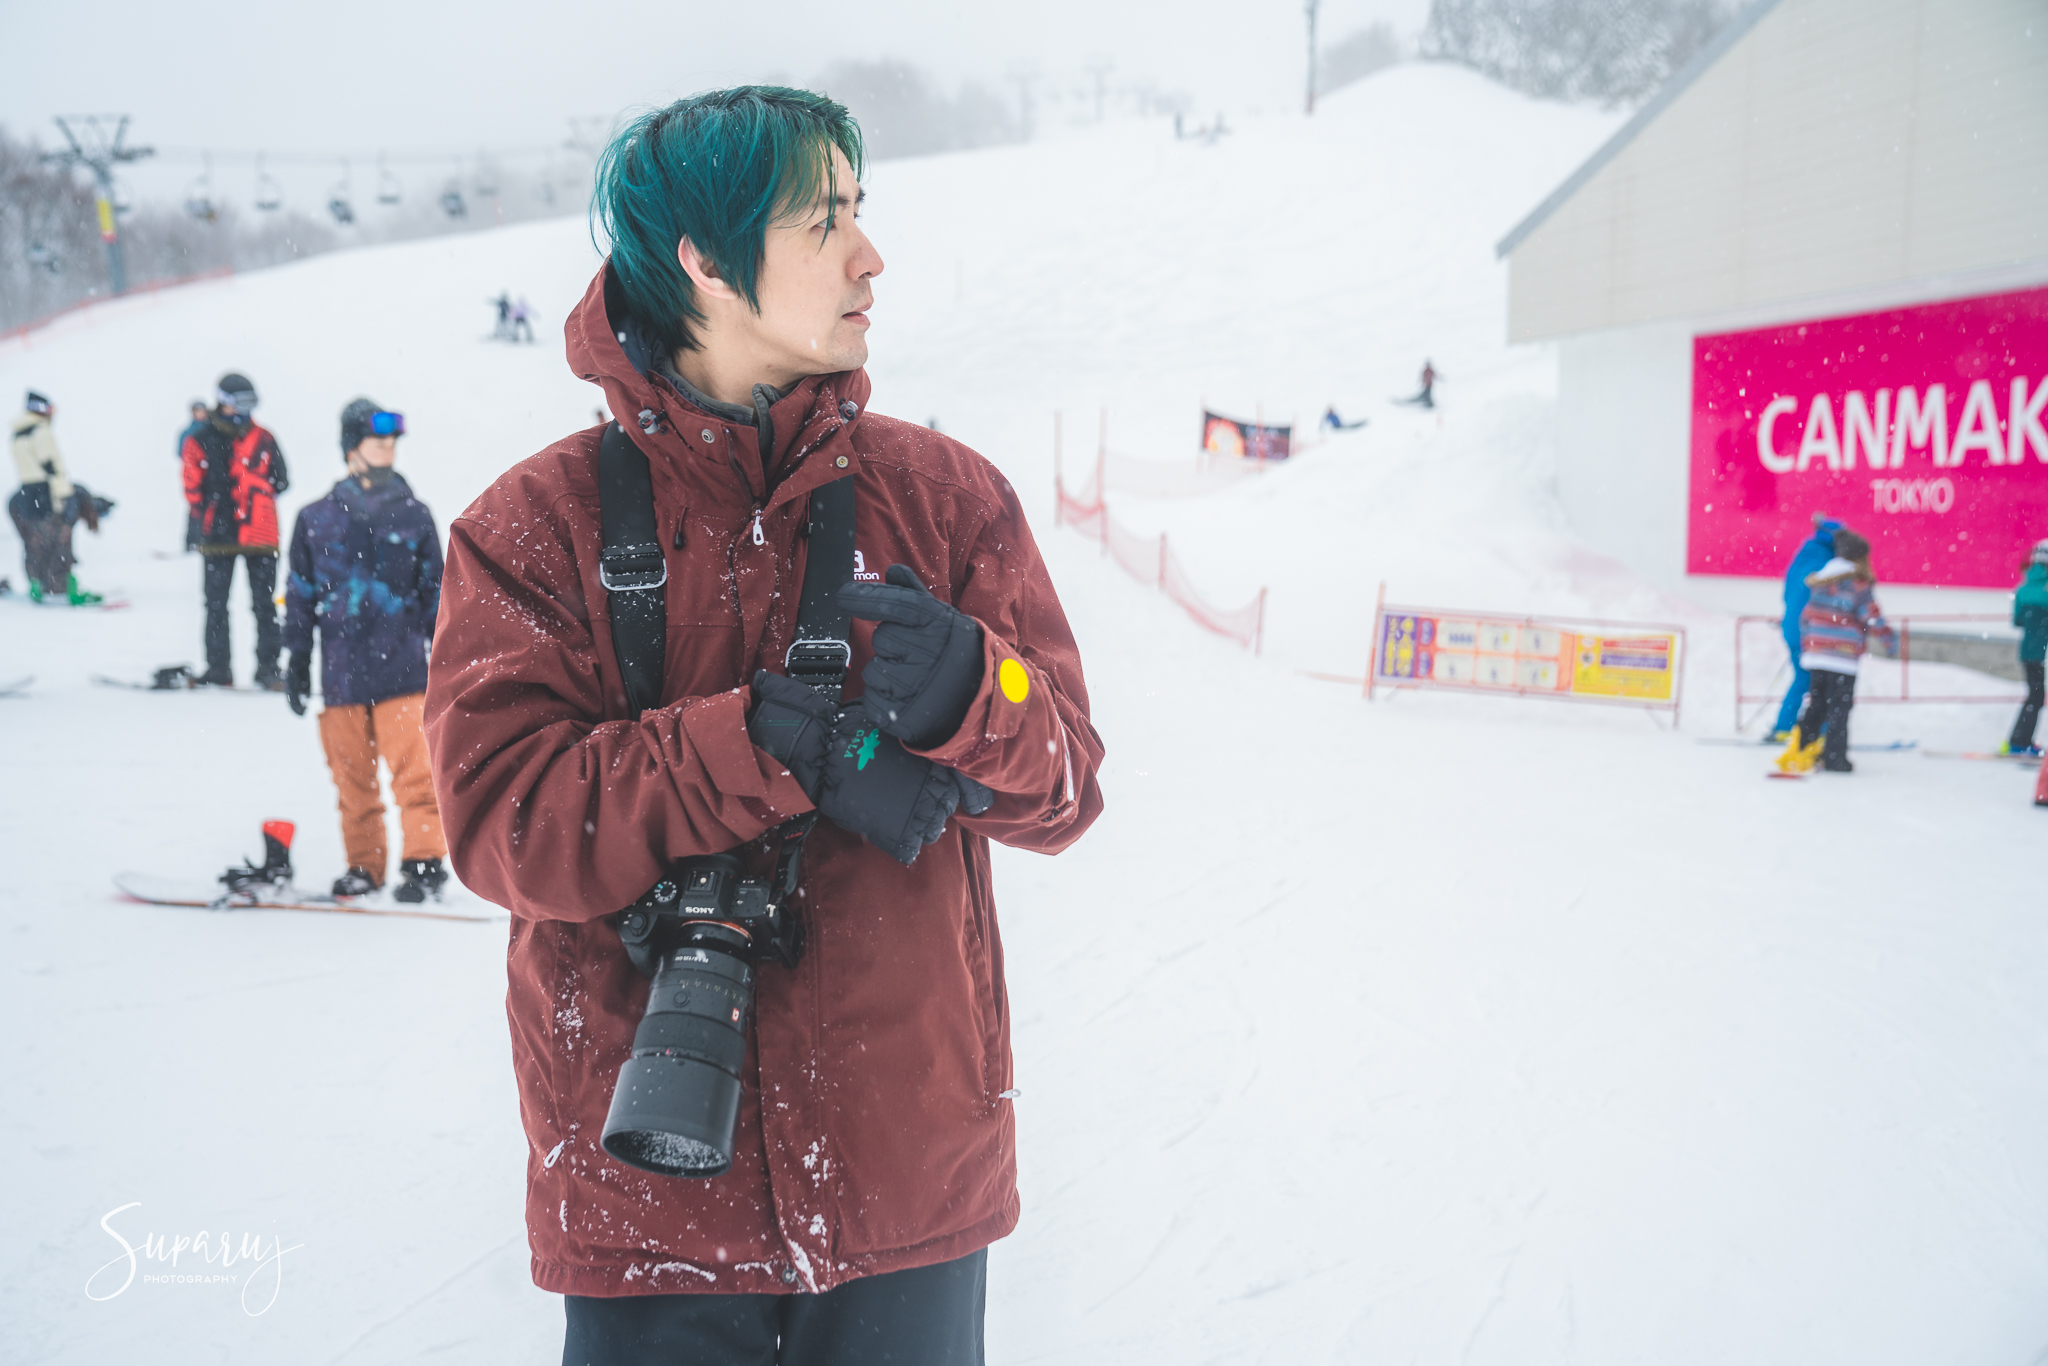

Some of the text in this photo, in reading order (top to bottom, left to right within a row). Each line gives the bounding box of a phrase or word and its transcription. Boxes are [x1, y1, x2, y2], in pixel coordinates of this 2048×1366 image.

[1756, 374, 2048, 474] CANMAK
[1870, 476, 1956, 515] TOKYO
[853, 572, 880, 581] mon
[843, 729, 865, 758] GALA
[685, 906, 715, 914] SONY
